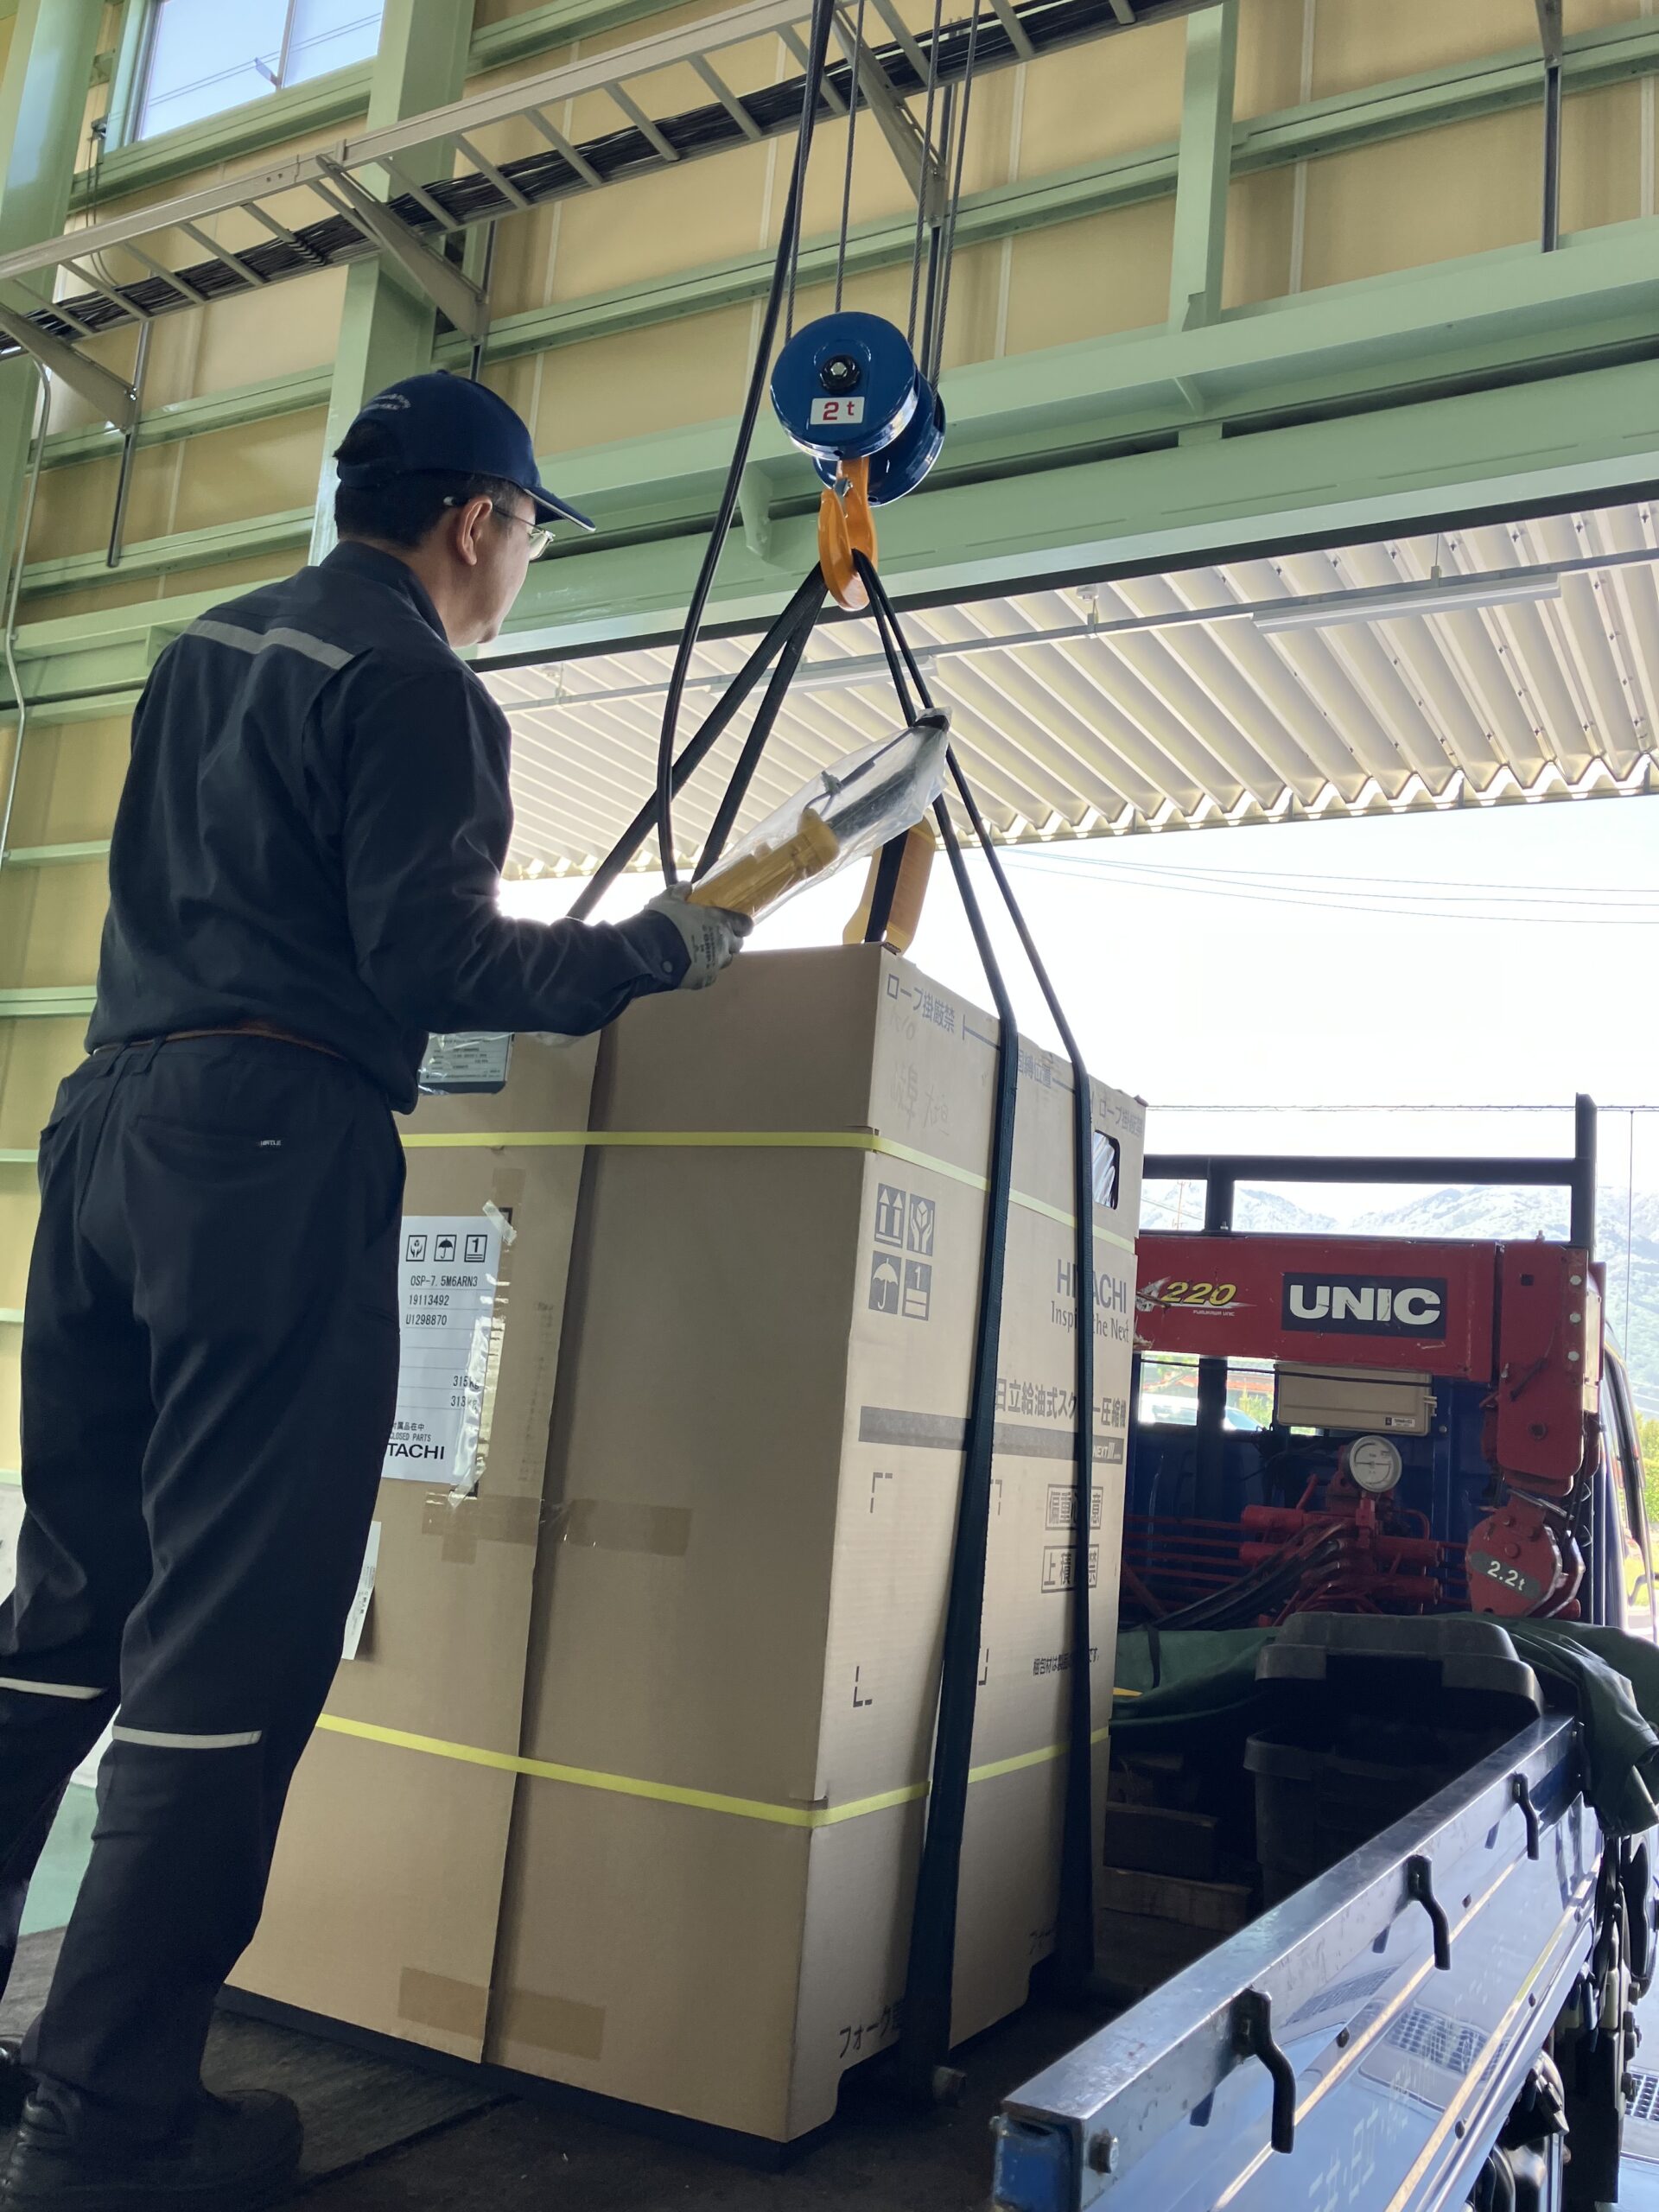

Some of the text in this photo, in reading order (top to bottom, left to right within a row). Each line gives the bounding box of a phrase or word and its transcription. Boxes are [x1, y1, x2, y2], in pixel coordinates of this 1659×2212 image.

[472, 1237, 480, 1253] 1
[1057, 1259, 1127, 1313] HIACHI
[1160, 1281, 1236, 1306] 220
[409, 1294, 449, 1306] 19113492
[1290, 1284, 1440, 1325] UNIC
[405, 1313, 448, 1325] U1298870
[1110, 1318, 1129, 1343] Next
[995, 1377, 1127, 1428] 日立給油式スクー圧縮機
[412, 1433, 432, 1442] PARTS
[1043, 1550, 1097, 1586] 上積禁
[1487, 1560, 1525, 1591] 2.2t
